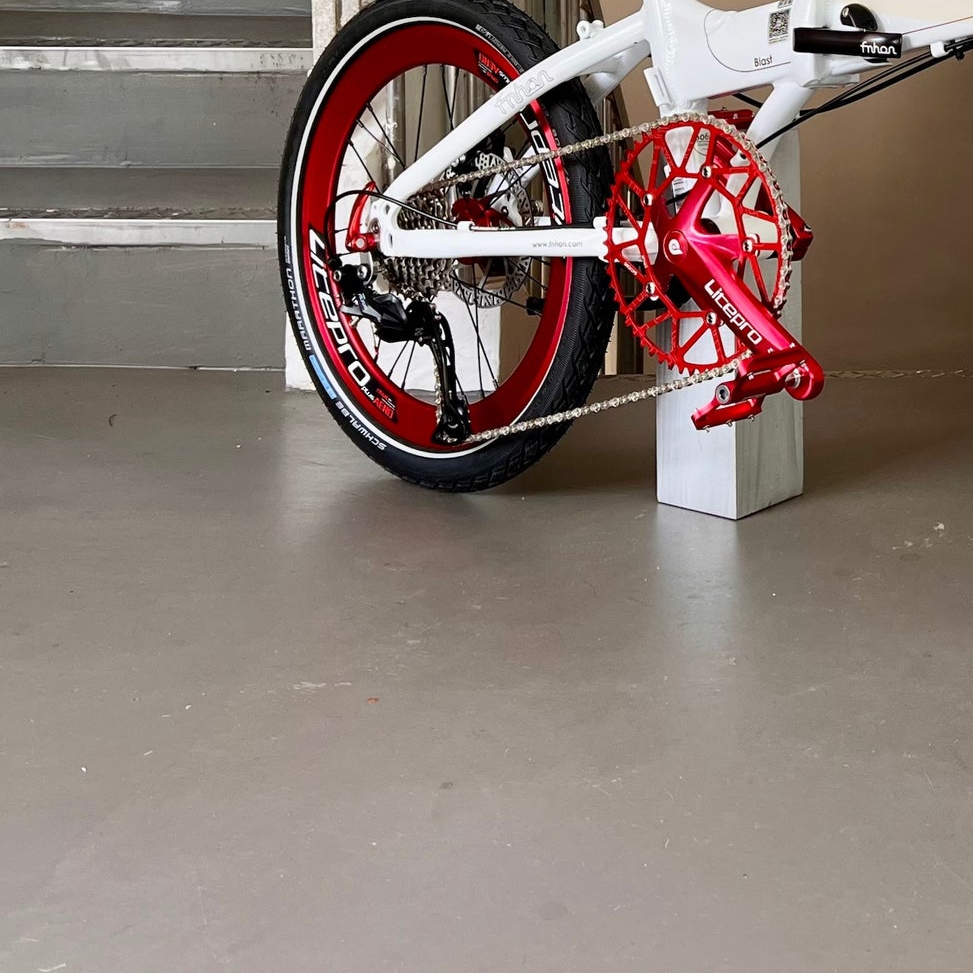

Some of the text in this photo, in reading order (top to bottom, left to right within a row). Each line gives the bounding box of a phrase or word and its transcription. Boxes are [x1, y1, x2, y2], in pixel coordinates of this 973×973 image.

[754, 55, 773, 67] Blast
[860, 41, 898, 56] fnhon
[286, 268, 312, 351] MARATHON
[309, 229, 371, 387] Litepro
[704, 279, 762, 345] Litepro
[334, 400, 387, 451] SCHWALBE
